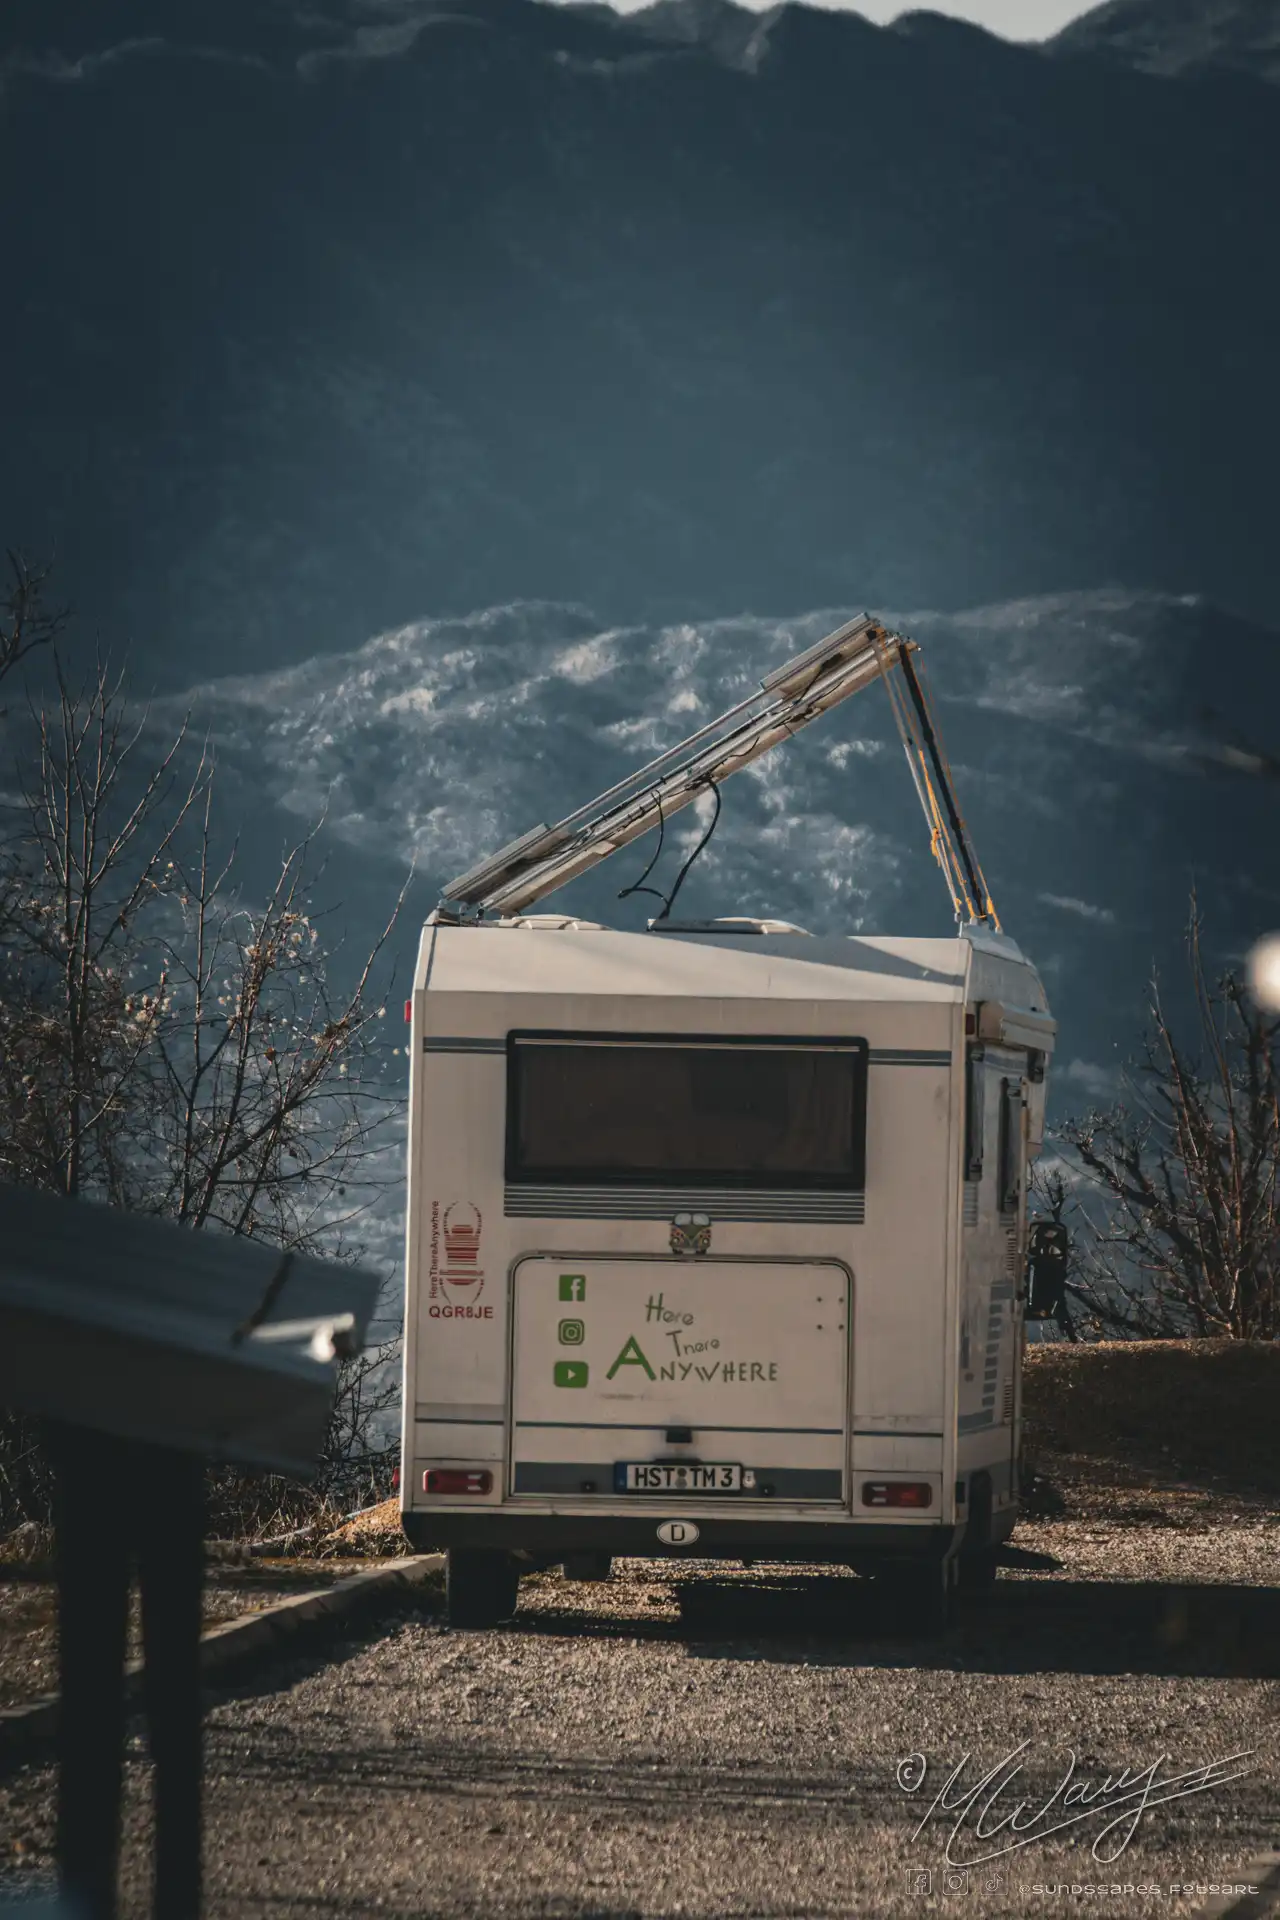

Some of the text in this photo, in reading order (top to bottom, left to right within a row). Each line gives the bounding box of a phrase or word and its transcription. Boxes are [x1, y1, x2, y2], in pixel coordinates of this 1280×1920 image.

[645, 1292, 694, 1326] Here
[634, 1467, 675, 1487] HST
[689, 1467, 716, 1487] TM
[720, 1467, 733, 1488] 3
[670, 1524, 686, 1542] D
